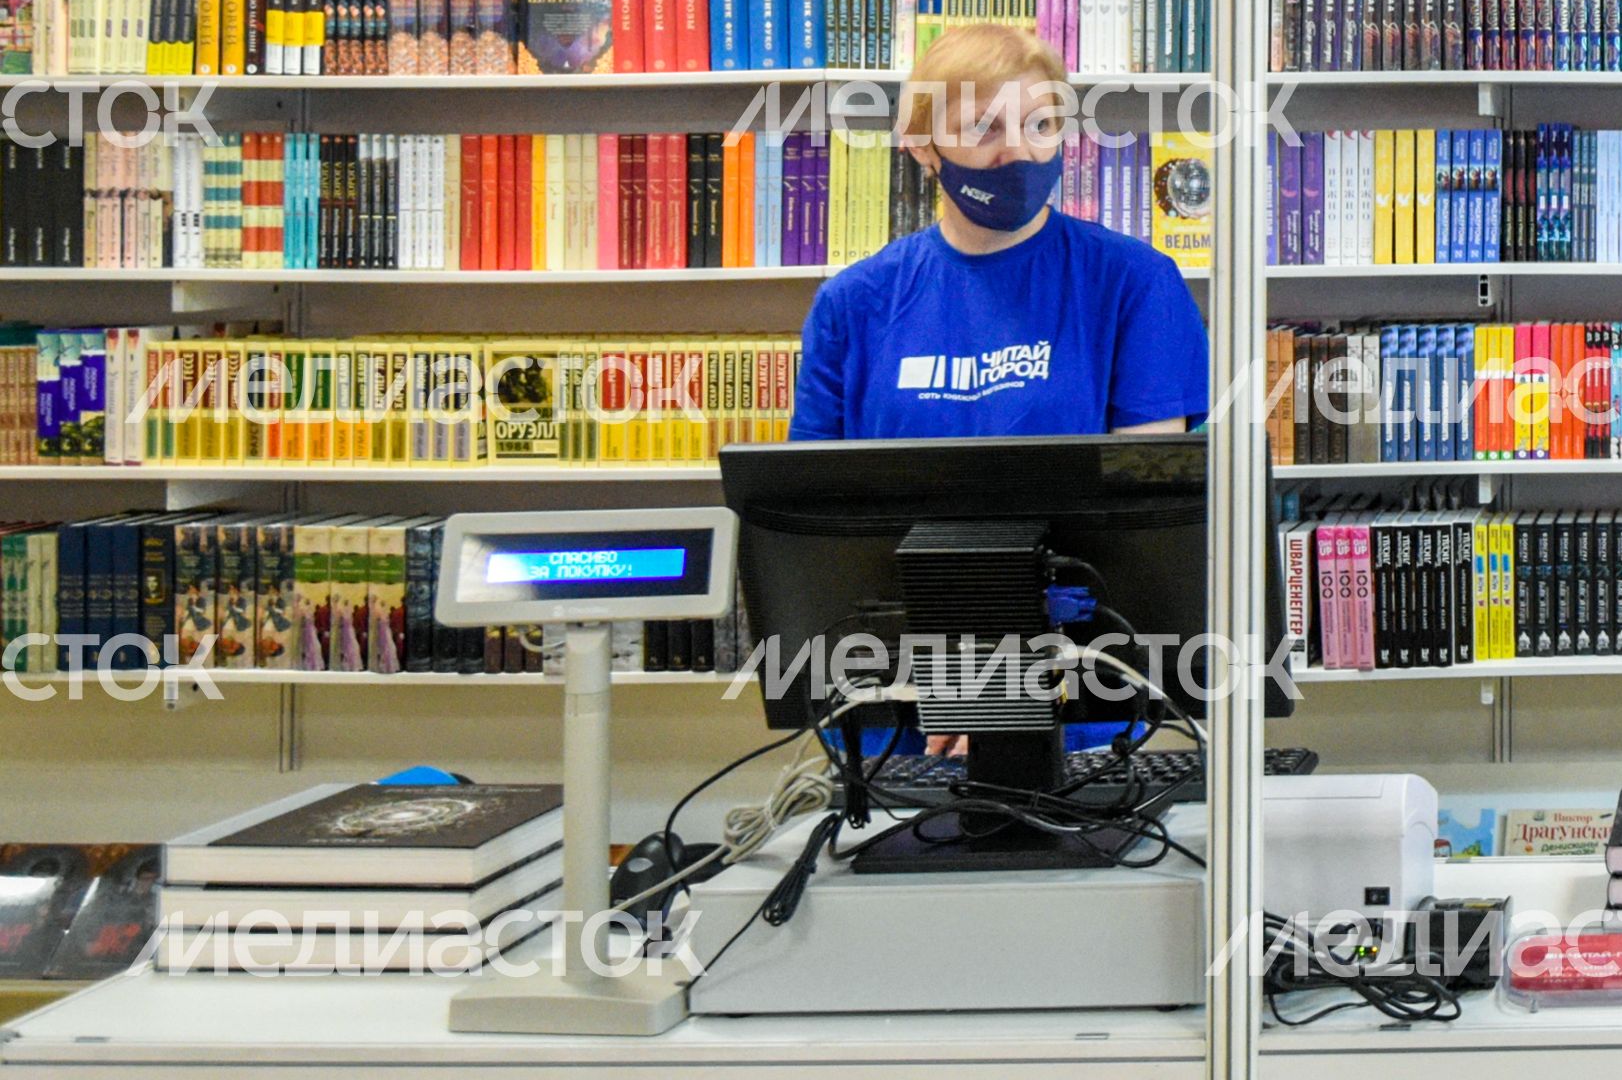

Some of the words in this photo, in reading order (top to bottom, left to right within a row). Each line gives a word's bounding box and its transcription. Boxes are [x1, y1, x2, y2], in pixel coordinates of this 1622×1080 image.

[982, 340, 1051, 368] ЧИТАЙ
[758, 353, 768, 387] ХАКСЛИ
[777, 353, 787, 387] ХАКСЛИ
[980, 360, 1049, 386] ГОРОД
[495, 421, 558, 440] ОРУЭЛЛ
[529, 565, 550, 578] ЗА
[549, 551, 618, 566] СПАСИБО
[1289, 538, 1304, 636] ШВАРЦЕНЕГГЕР
[1322, 569, 1333, 598] 100
[1340, 569, 1351, 598] 100
[1357, 569, 1368, 598] 100
[1553, 812, 1593, 824] Виктор
[1513, 822, 1611, 844] Драгунски
